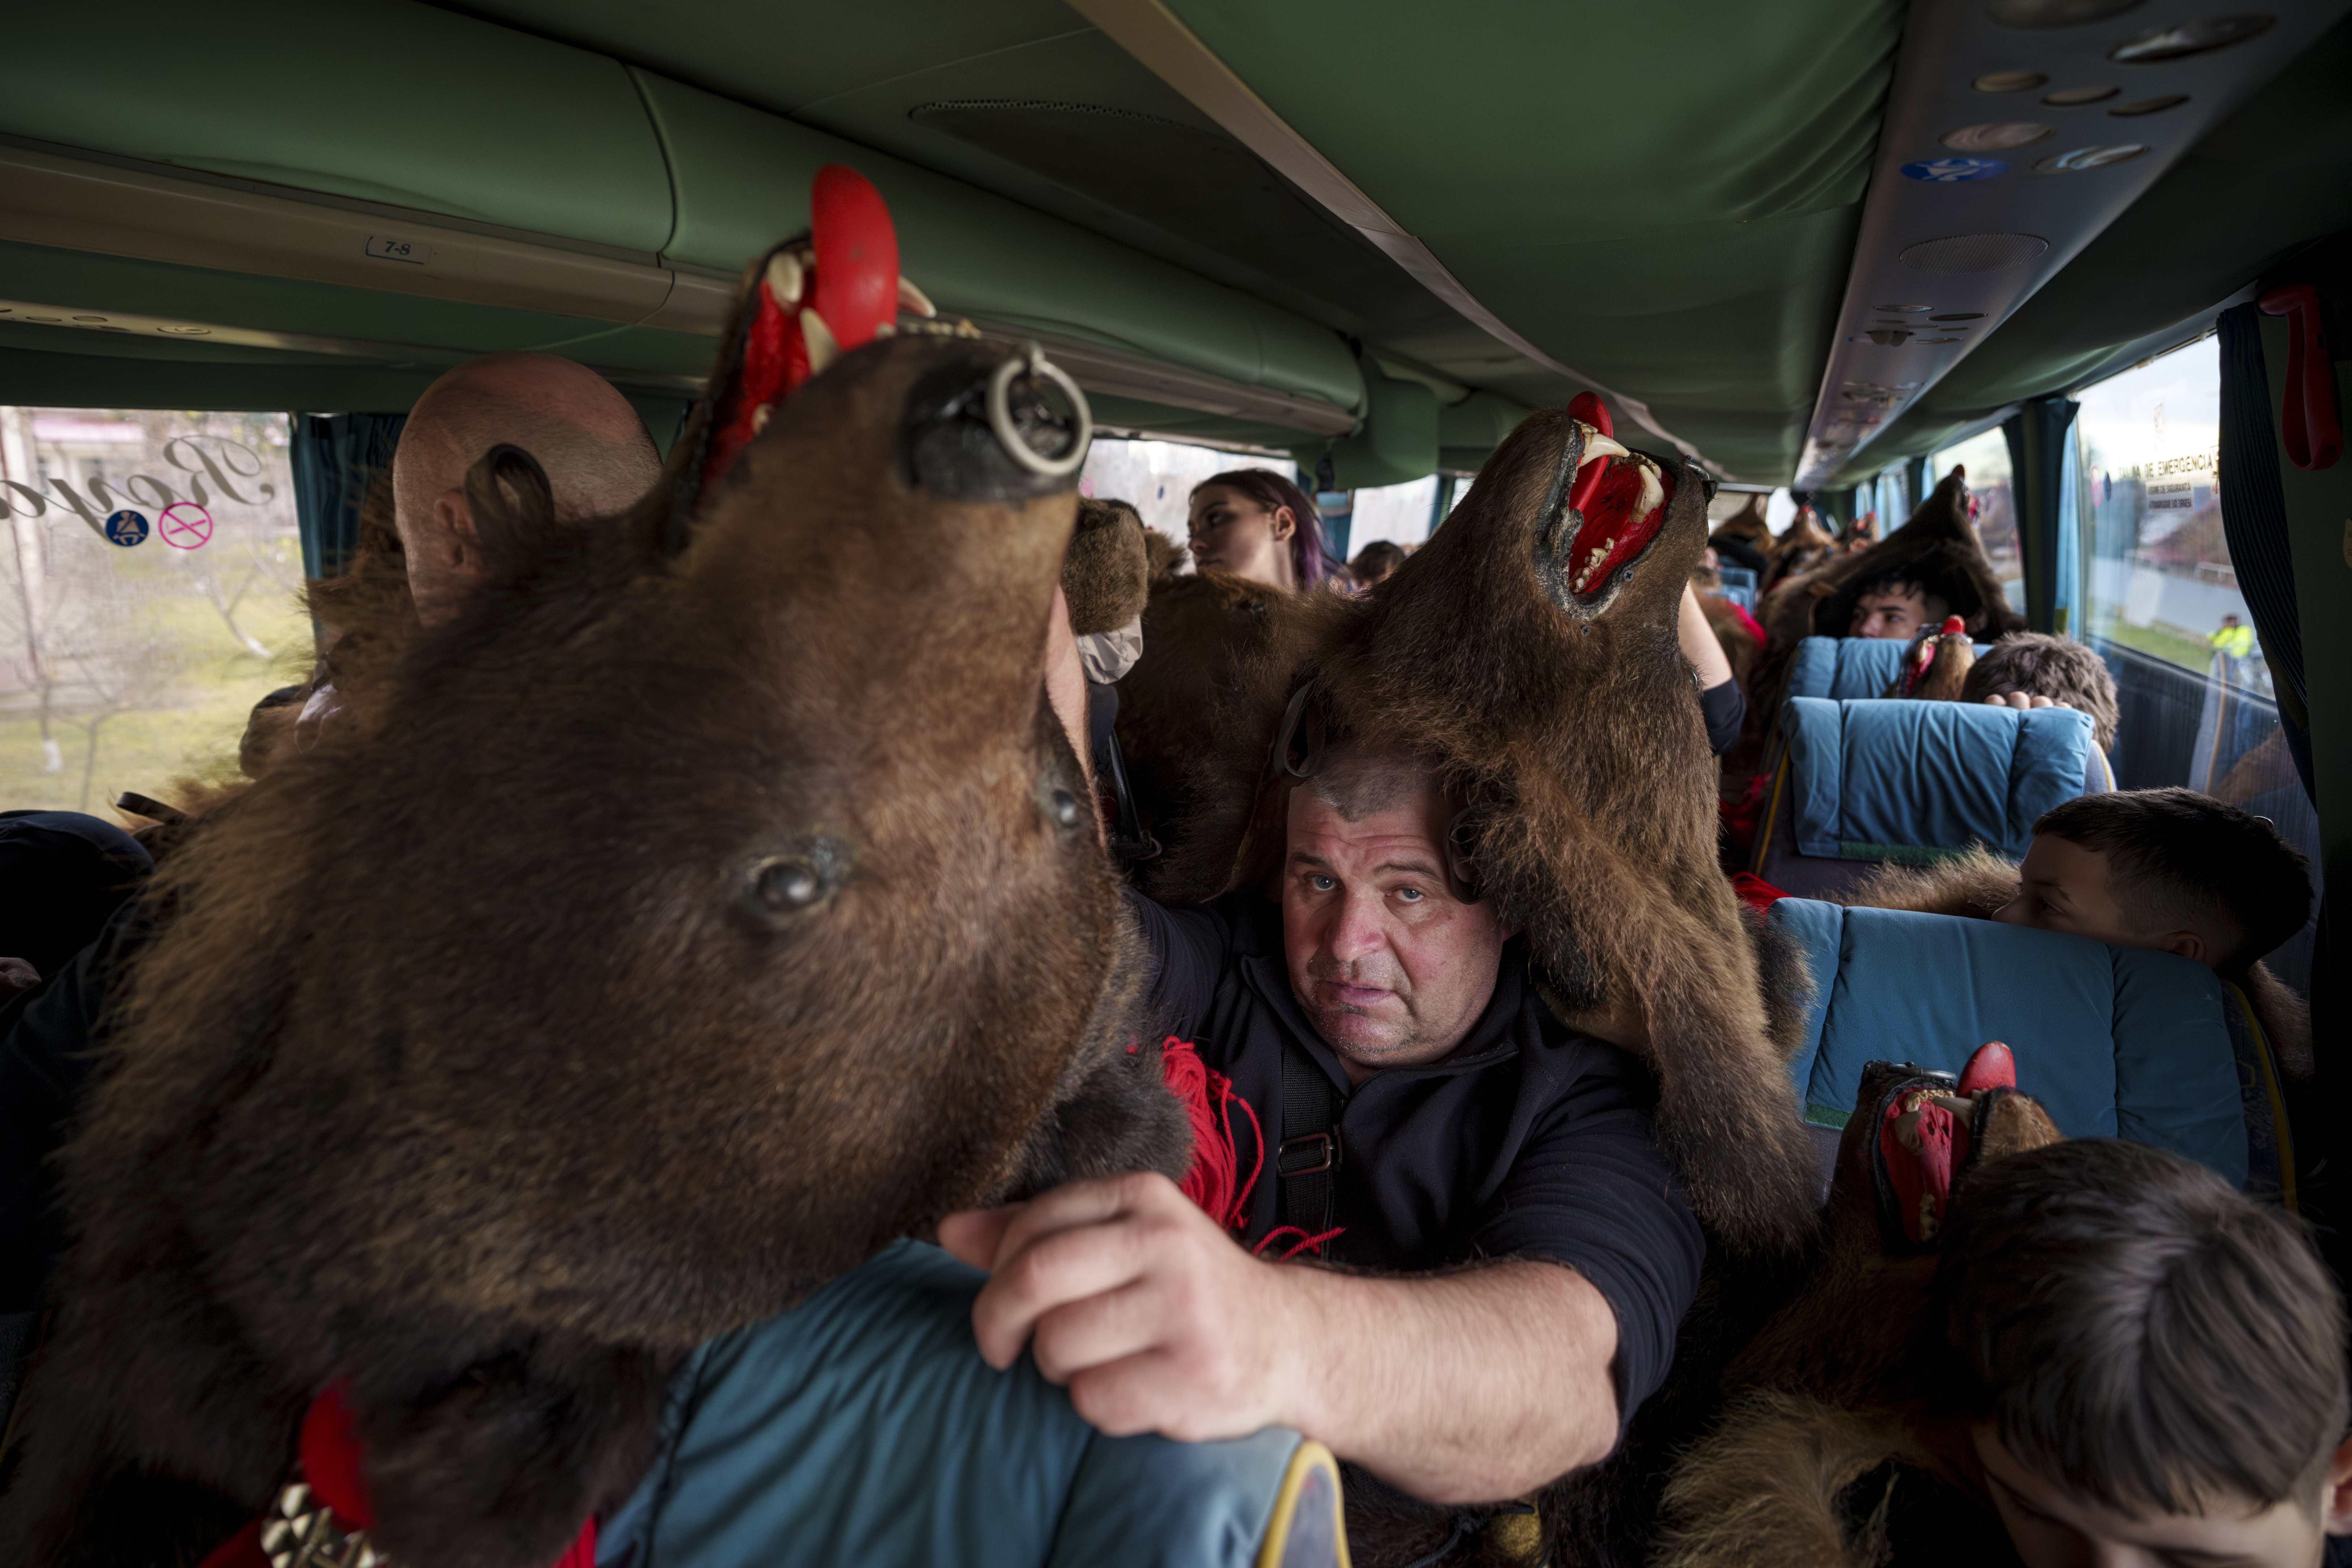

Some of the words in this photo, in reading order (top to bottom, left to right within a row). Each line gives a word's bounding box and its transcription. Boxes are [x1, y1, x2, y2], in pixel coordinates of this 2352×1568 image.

[385, 241, 411, 255] 7-8
[2144, 462, 2153, 477] DE
[2158, 453, 2213, 476] EMERGENCIA
